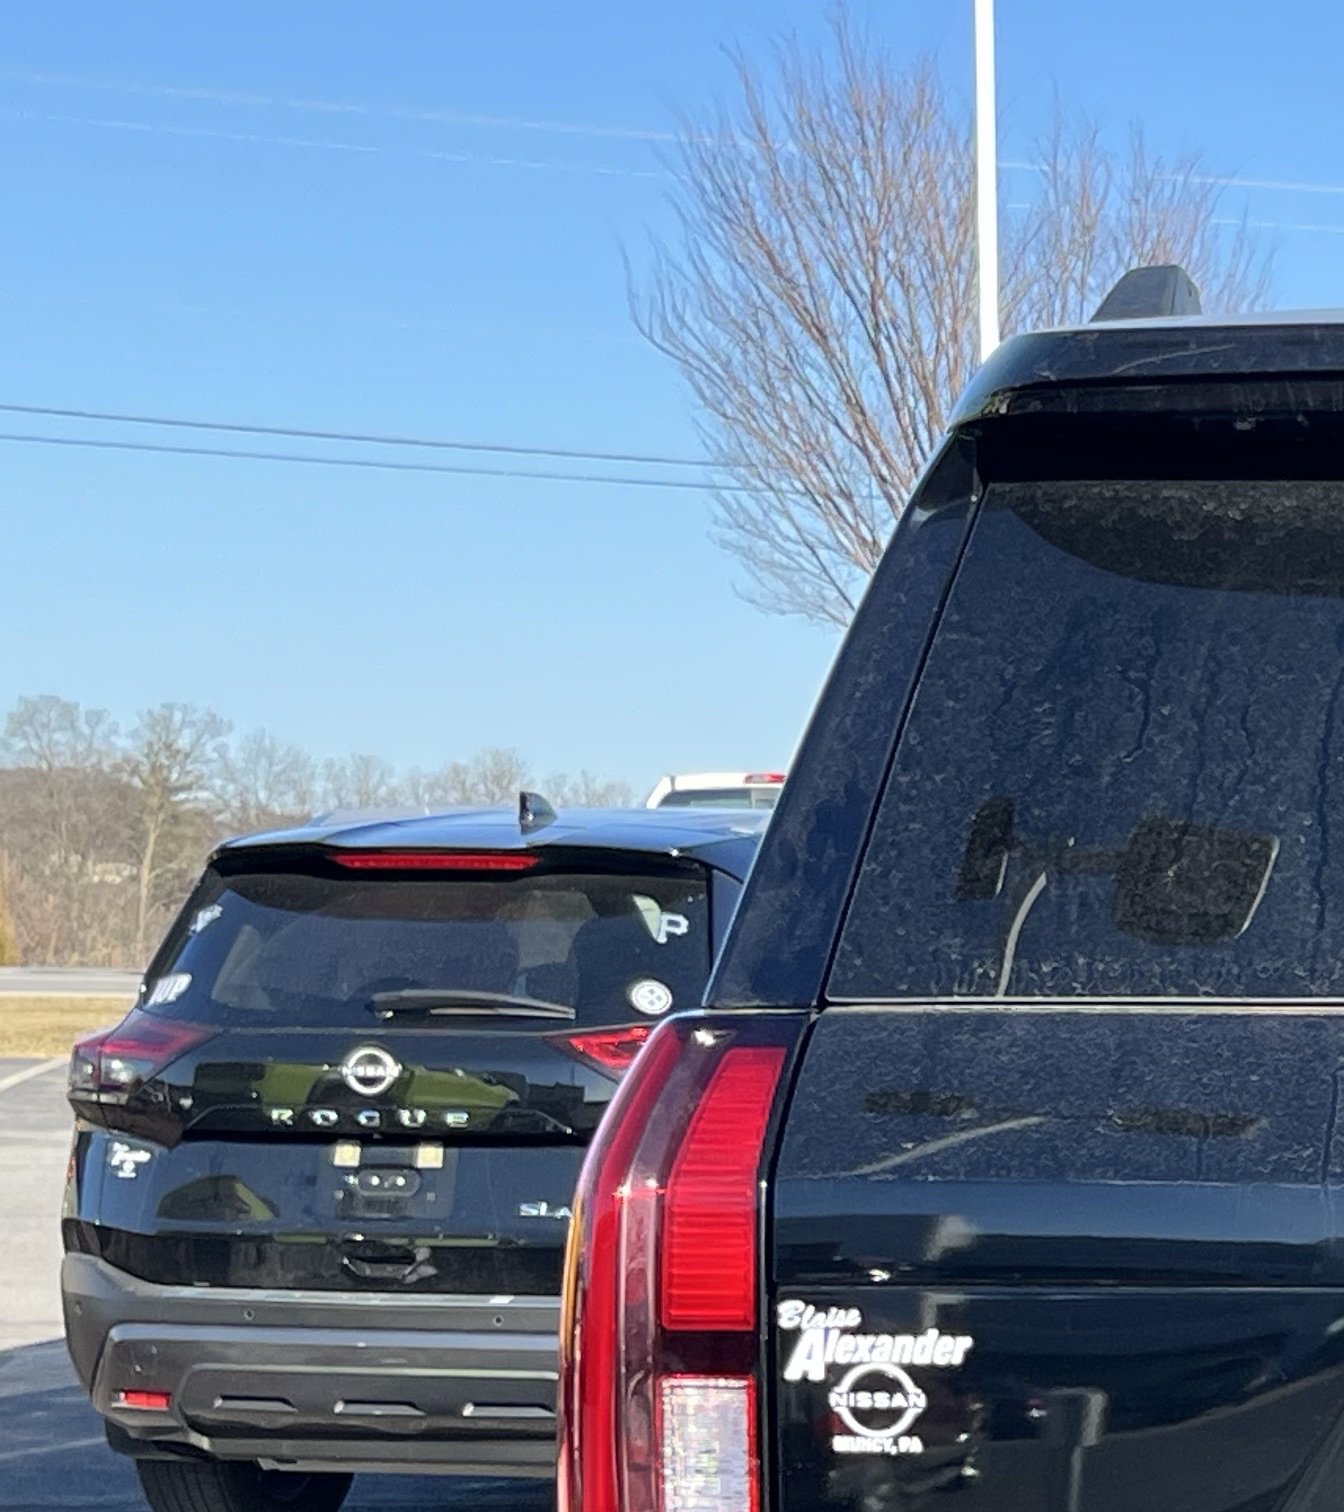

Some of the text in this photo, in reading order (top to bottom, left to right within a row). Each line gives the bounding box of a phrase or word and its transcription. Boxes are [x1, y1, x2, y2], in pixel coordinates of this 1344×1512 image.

[269, 1107, 469, 1128] ROGUE
[777, 1299, 862, 1331] Blaise
[783, 1327, 975, 1382] Alexander
[829, 1390, 927, 1410] NISSAN
[898, 1435, 924, 1454] PA
